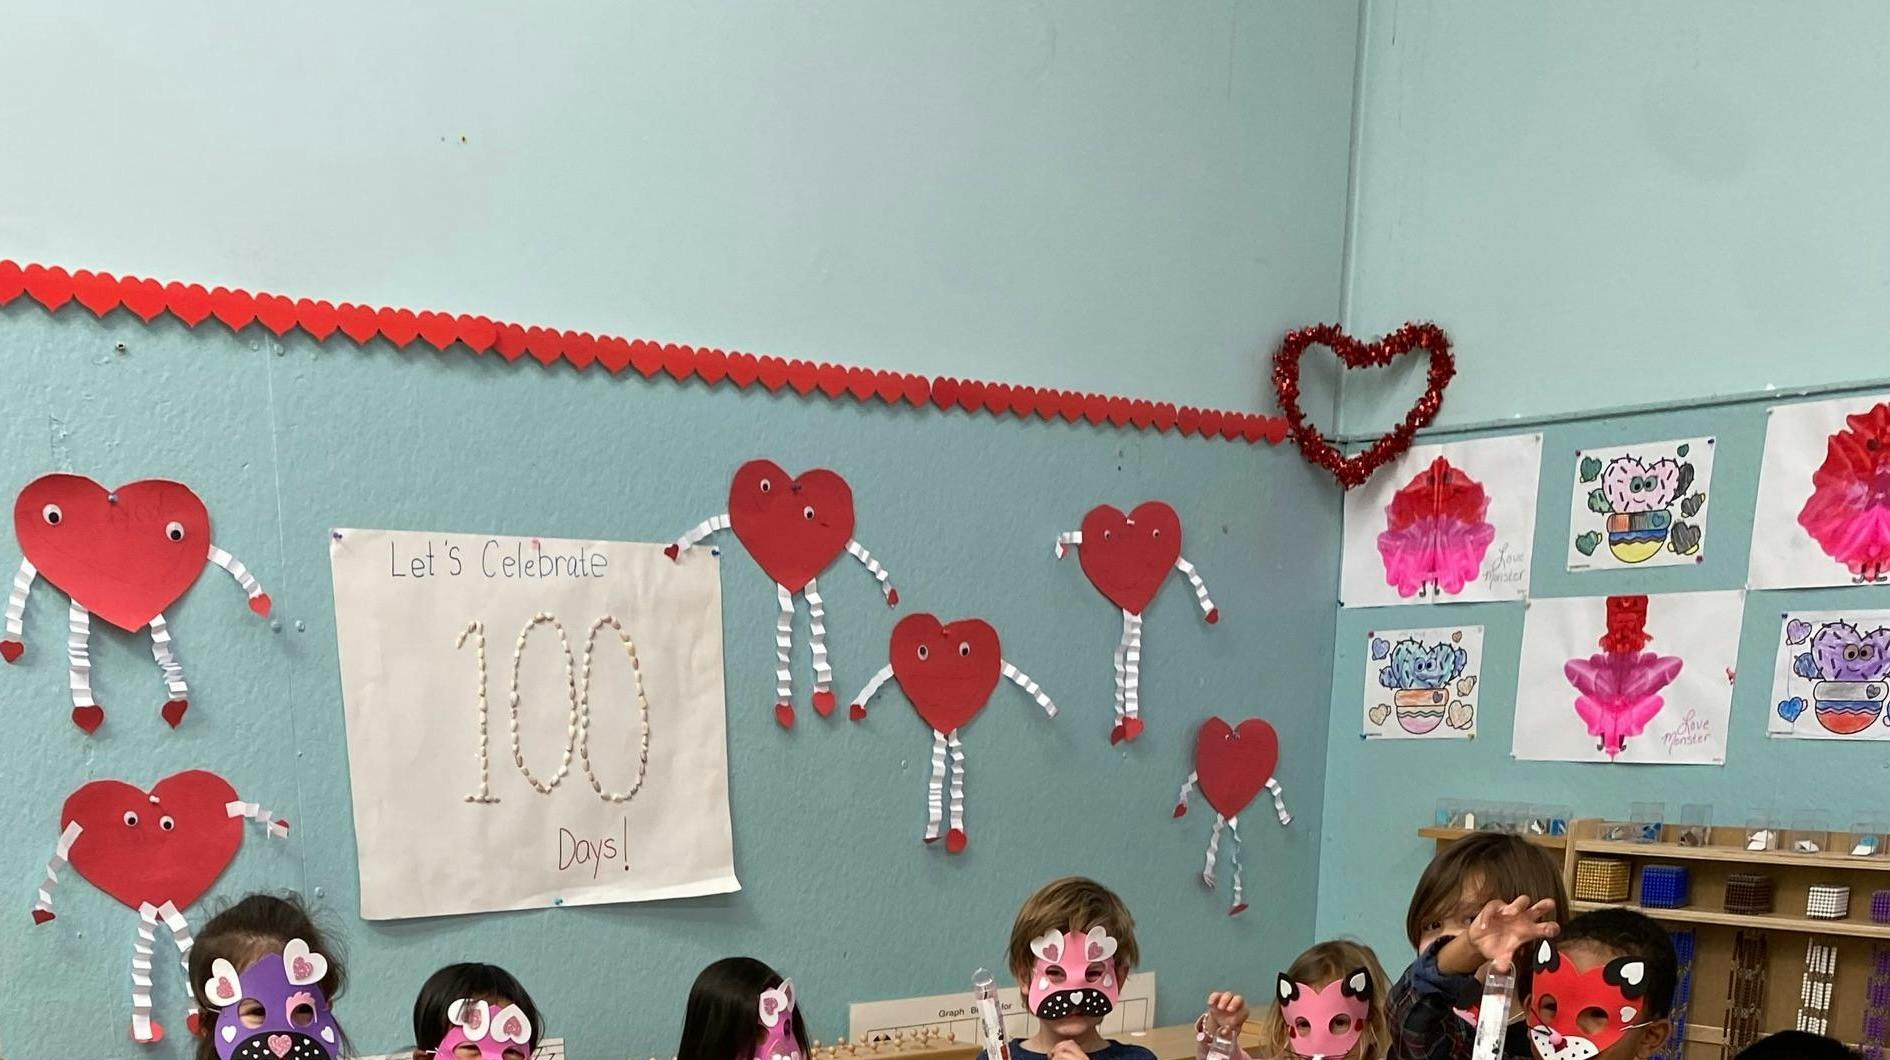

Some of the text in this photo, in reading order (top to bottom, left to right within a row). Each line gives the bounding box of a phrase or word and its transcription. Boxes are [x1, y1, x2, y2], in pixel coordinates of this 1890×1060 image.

[482, 539, 609, 578] Celebrate
[456, 611, 650, 803] 100
[559, 816, 630, 879] Days!
[938, 1008, 965, 1018] Graph
